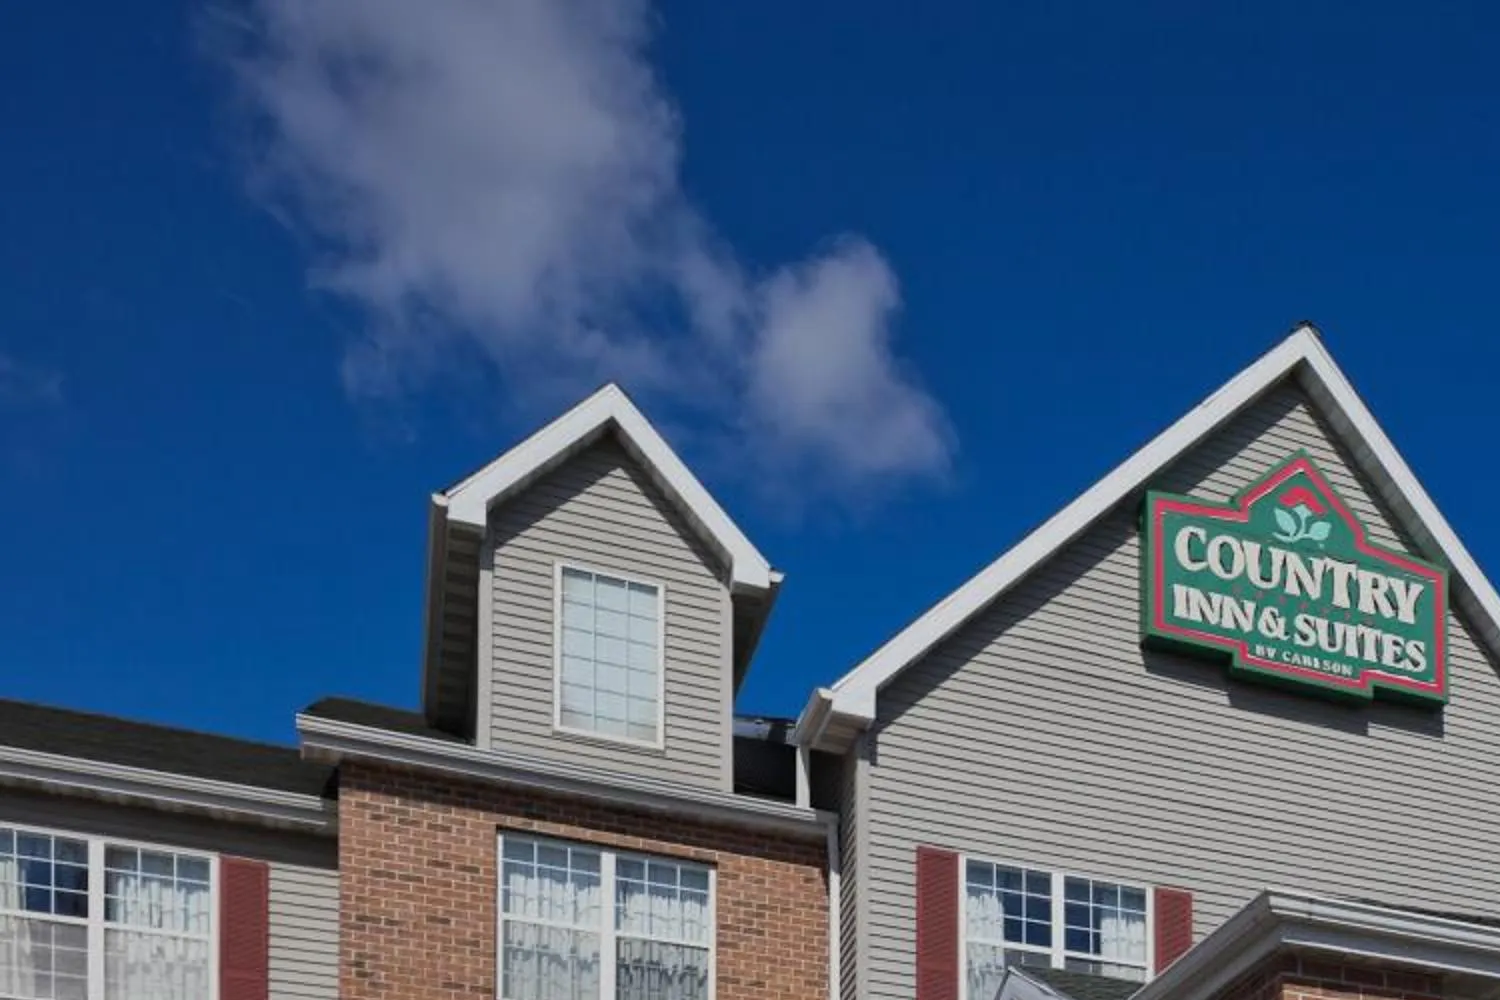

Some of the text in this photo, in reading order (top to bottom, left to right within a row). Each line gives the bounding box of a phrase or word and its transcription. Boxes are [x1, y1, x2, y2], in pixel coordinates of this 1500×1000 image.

[1173, 526, 1424, 624] COUNTRY
[1173, 584, 1427, 673] INN & SUITES
[1255, 645, 1353, 677] BY CARLSON
